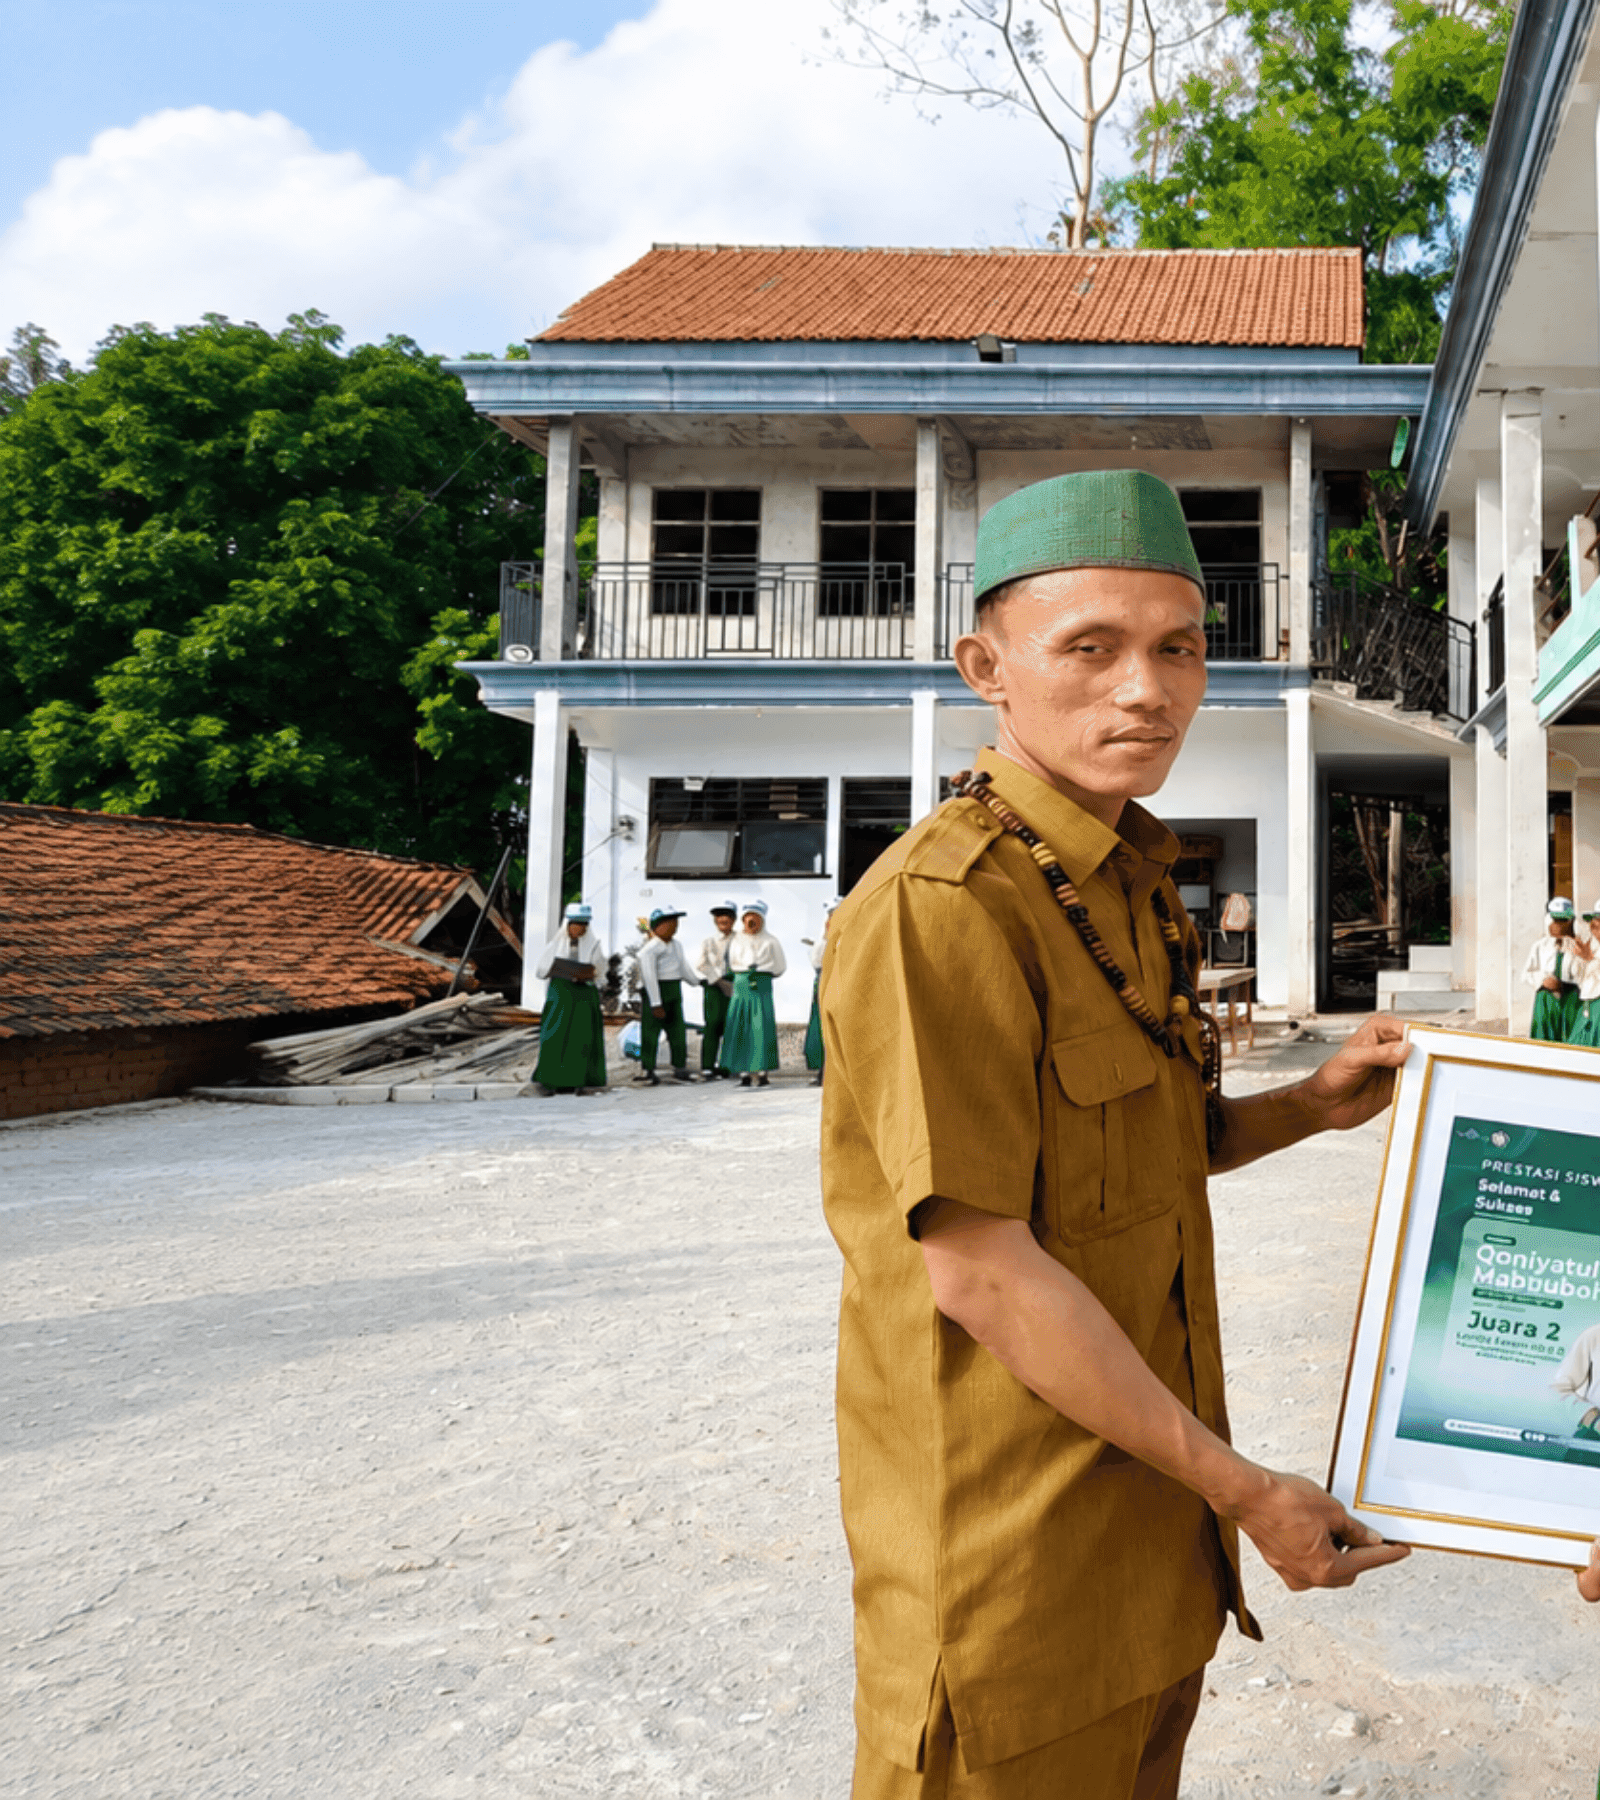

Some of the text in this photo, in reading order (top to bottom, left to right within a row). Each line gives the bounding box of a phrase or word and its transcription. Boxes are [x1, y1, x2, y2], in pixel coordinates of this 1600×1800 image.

[1481, 1159, 1560, 1181] PRESTASI
[1476, 1244, 1600, 1278] Qoniyatul
[1467, 1310, 1561, 1342] Juara 2
